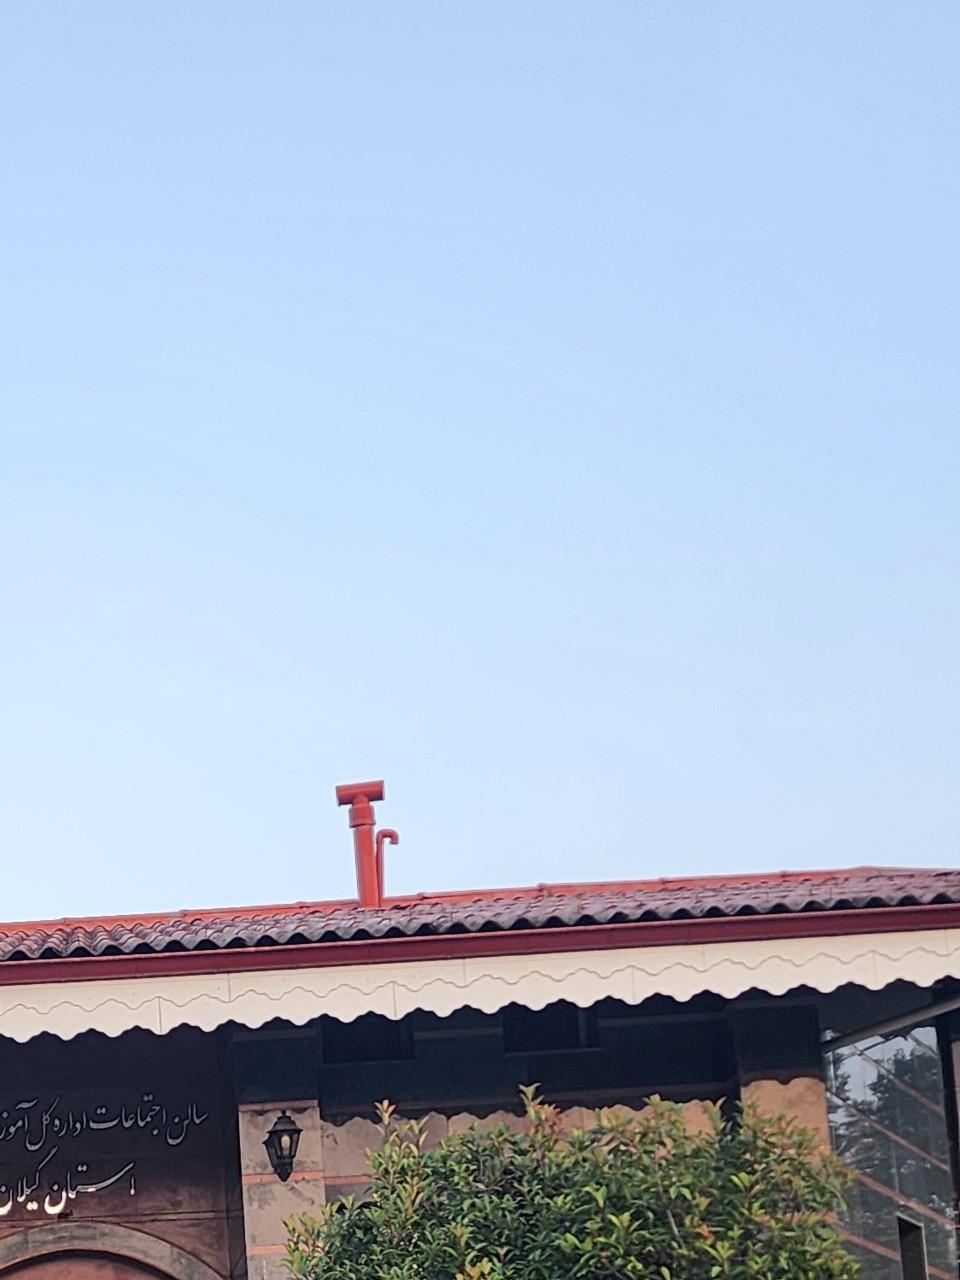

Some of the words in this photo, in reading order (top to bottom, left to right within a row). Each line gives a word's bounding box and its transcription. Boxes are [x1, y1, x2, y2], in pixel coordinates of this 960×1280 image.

[53, 1111, 87, 1137] اداره
[89, 1094, 167, 1136] اجتماعات
[166, 1103, 208, 1146] سالن
[43, 1162, 136, 1215] استان
